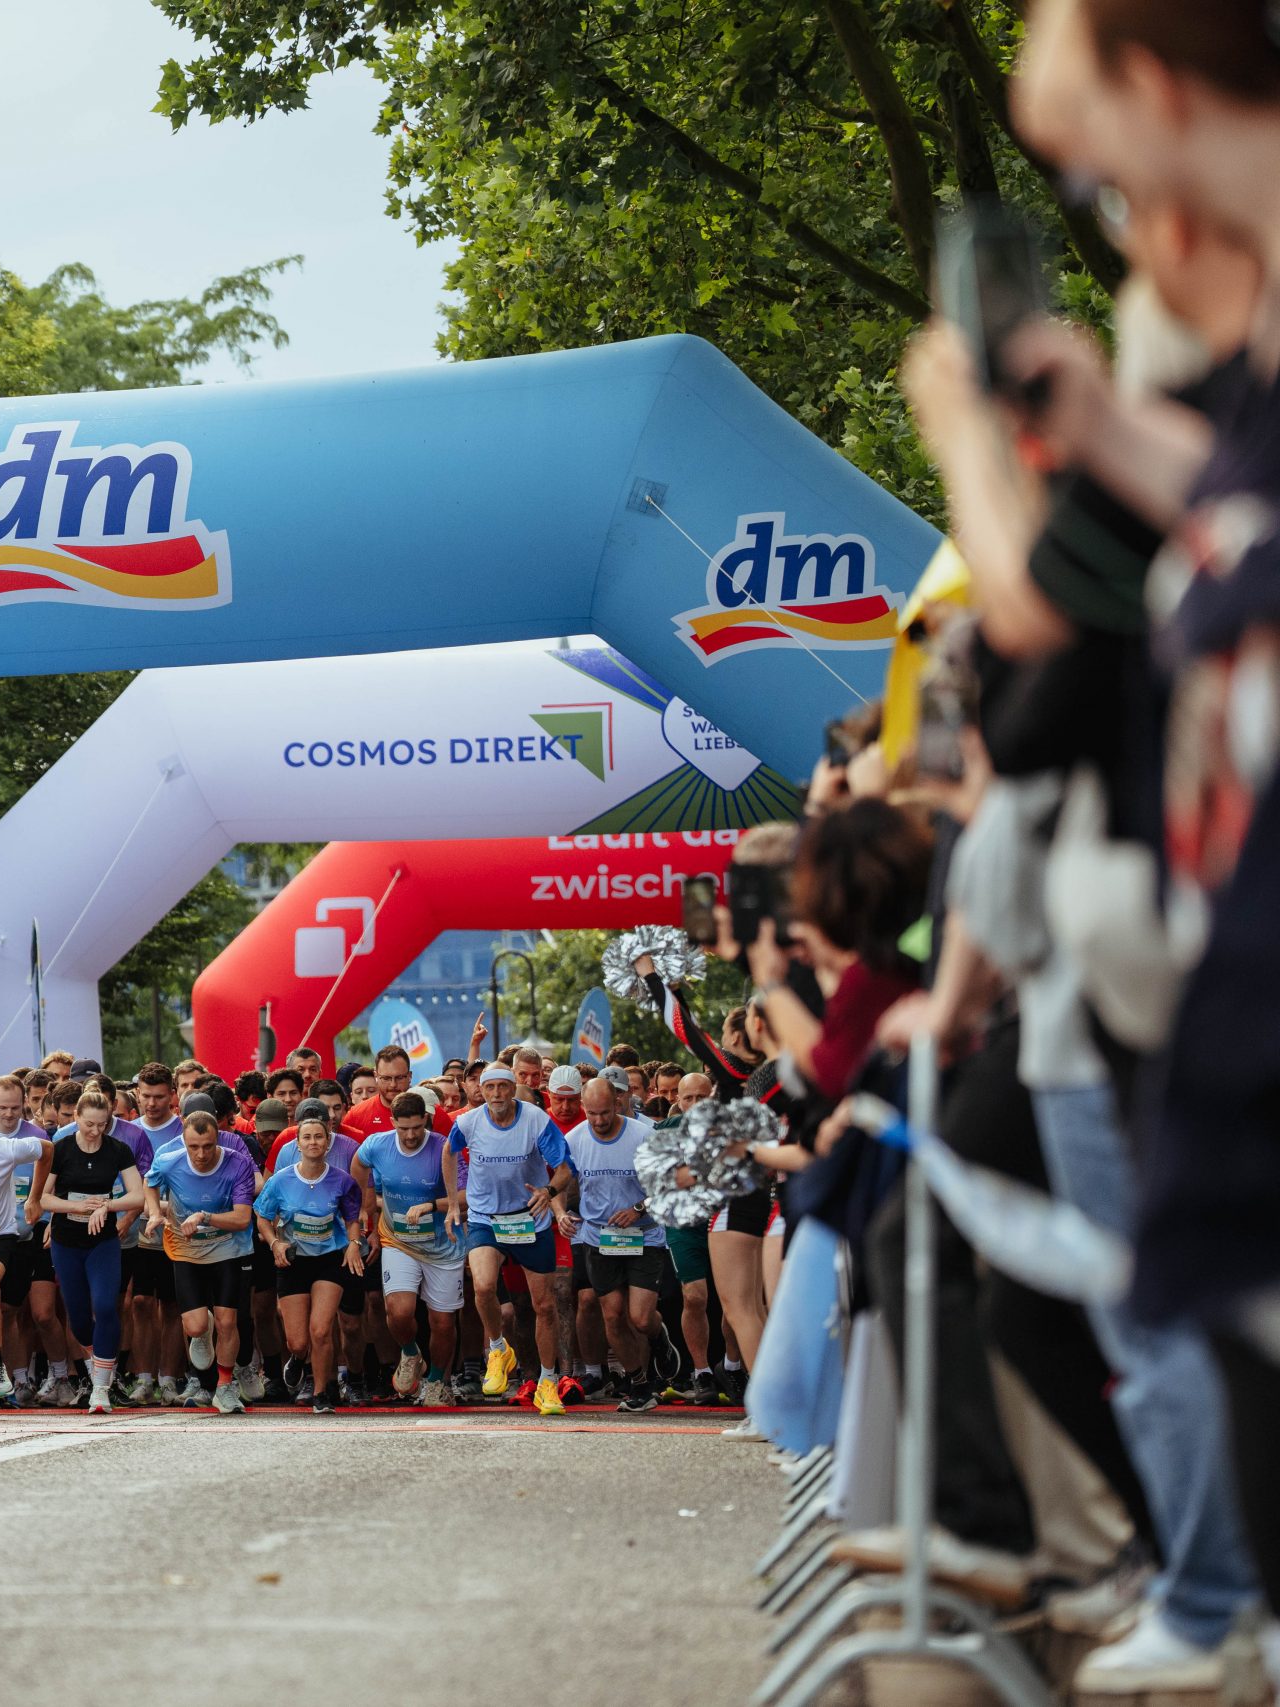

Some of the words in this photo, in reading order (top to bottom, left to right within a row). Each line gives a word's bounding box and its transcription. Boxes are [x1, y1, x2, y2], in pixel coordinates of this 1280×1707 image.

[716, 521, 865, 608] dm
[283, 739, 437, 768] COSMOS
[450, 734, 583, 764] DIREKT
[392, 1025, 422, 1050] dm
[584, 1014, 602, 1043] dm
[499, 1224, 526, 1232] Wolfgang
[610, 1235, 632, 1243] Markus
